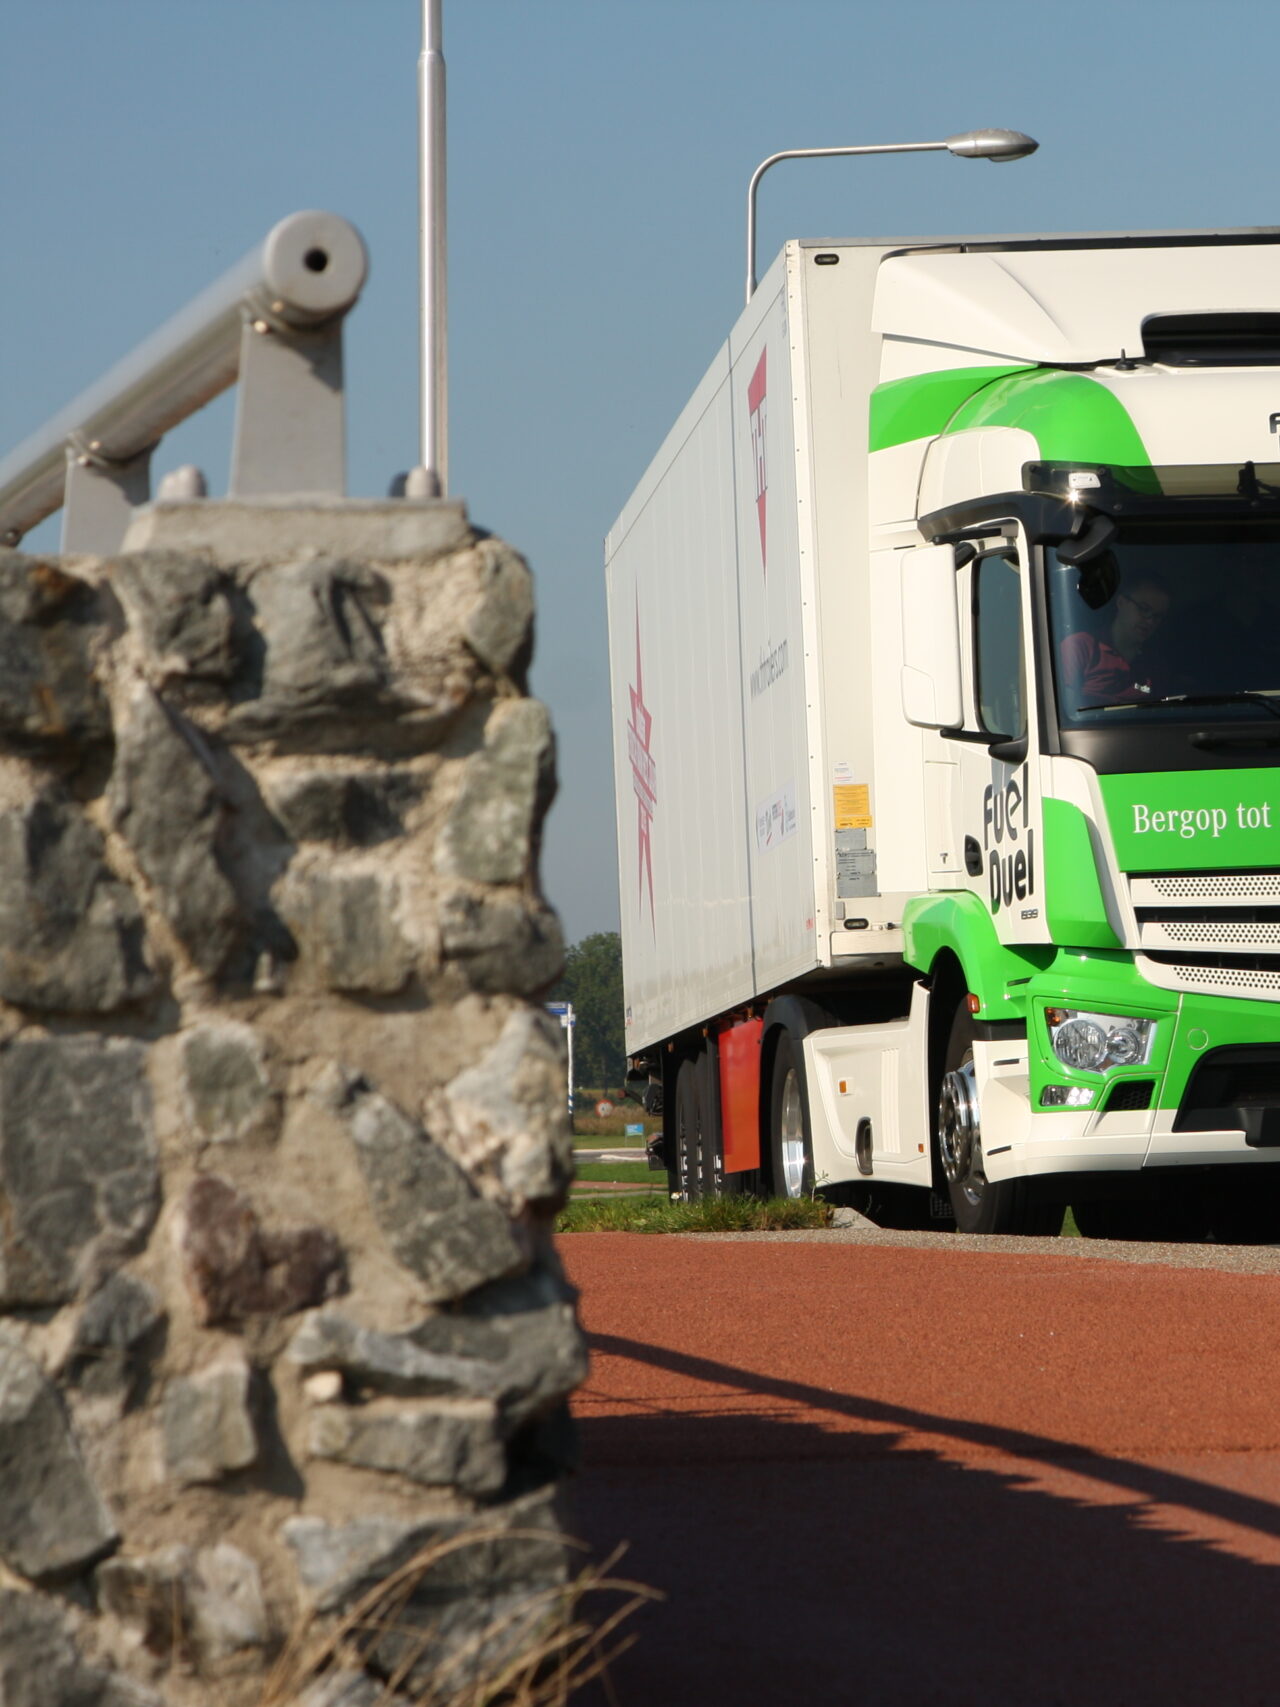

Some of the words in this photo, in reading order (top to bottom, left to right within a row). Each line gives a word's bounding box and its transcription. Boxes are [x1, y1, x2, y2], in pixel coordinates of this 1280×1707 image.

[984, 761, 1029, 850] Fuel
[1132, 803, 1227, 838] Bergop
[1236, 802, 1271, 828] tot
[989, 829, 1034, 915] Duel
